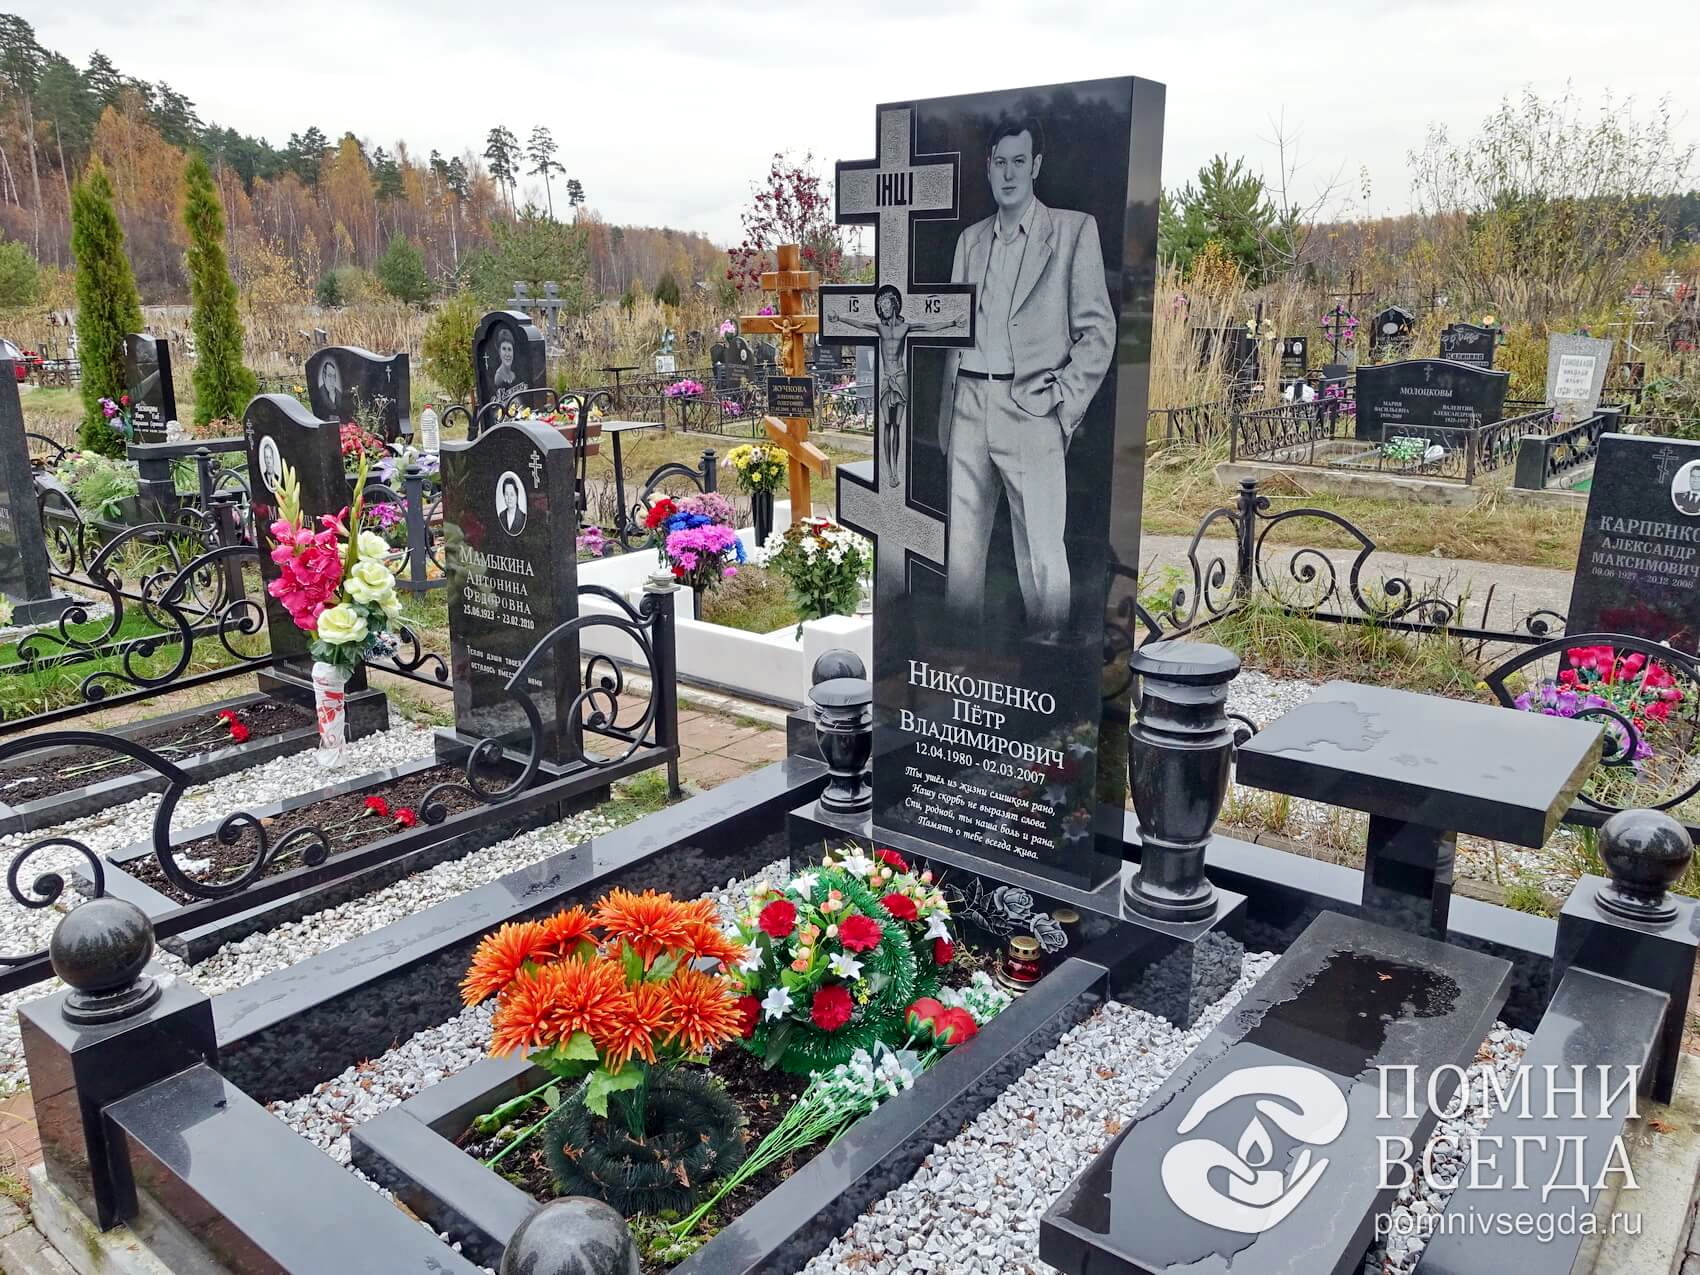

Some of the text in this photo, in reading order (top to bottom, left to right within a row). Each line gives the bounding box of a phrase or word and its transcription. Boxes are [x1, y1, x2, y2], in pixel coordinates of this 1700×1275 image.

[460, 545, 535, 577] МАМЫКИНА
[1591, 551, 1700, 578] МАКСИМОВИЧ
[1601, 537, 1696, 560] АЛЕКСАНДР
[466, 569, 529, 596] АНТОНИНА
[908, 659, 1057, 715] НИКОЛЕНКО
[952, 698, 1006, 730] ПЁТР
[899, 708, 1065, 770] ВЛАДИМИРОВИЧ
[915, 742, 973, 767] 12.04.1980
[983, 759, 1046, 785] 02.03.2007
[905, 766, 1056, 817] Ты ушёл из жизни слишком рано,
[912, 783, 1047, 829] Нашу скорбь не выразят слова.
[905, 797, 922, 811] Спи,
[924, 804, 955, 820] родной,
[958, 814, 973, 824] ты
[975, 819, 998, 831] наша
[1000, 823, 1020, 838] боль
[1030, 835, 1055, 849] рана,
[918, 815, 1039, 860] Память о тебе всегда жива.
